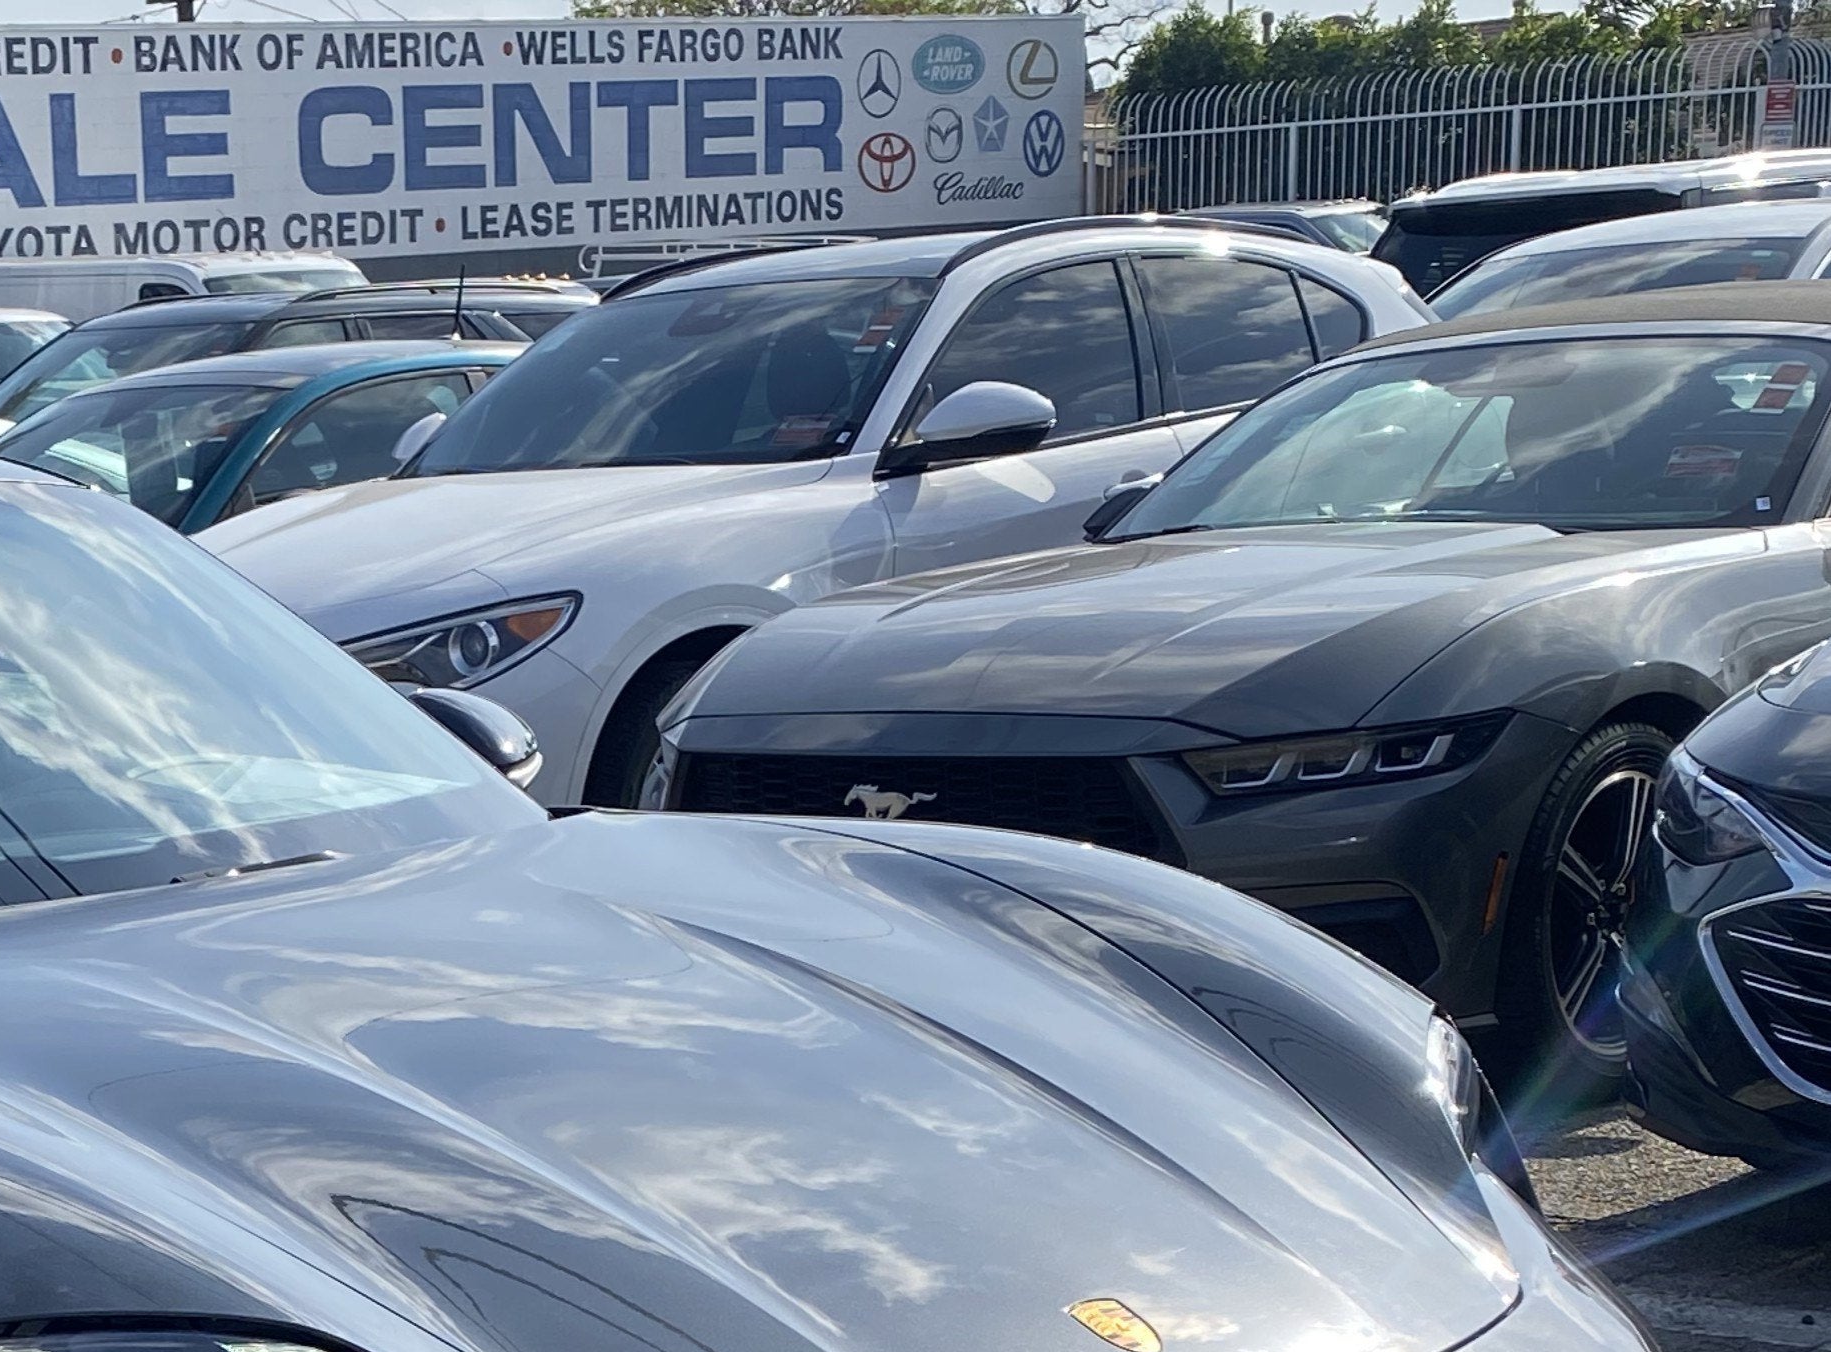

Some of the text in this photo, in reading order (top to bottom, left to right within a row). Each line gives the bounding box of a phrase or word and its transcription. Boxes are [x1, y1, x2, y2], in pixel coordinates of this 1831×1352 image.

[134, 34, 242, 72] BANK
[257, 34, 304, 70] OF
[316, 32, 484, 69] AMERICA
[516, 30, 624, 65] WELLS
[638, 28, 744, 62] FARGO
[758, 27, 843, 60] BANK
[298, 75, 843, 195] CENTER
[933, 171, 1024, 205] Cadillac
[114, 216, 266, 255] MOTOR
[283, 208, 423, 249] CREDIT
[462, 202, 574, 240] LEASE
[586, 187, 843, 234] TERMINATIONS
